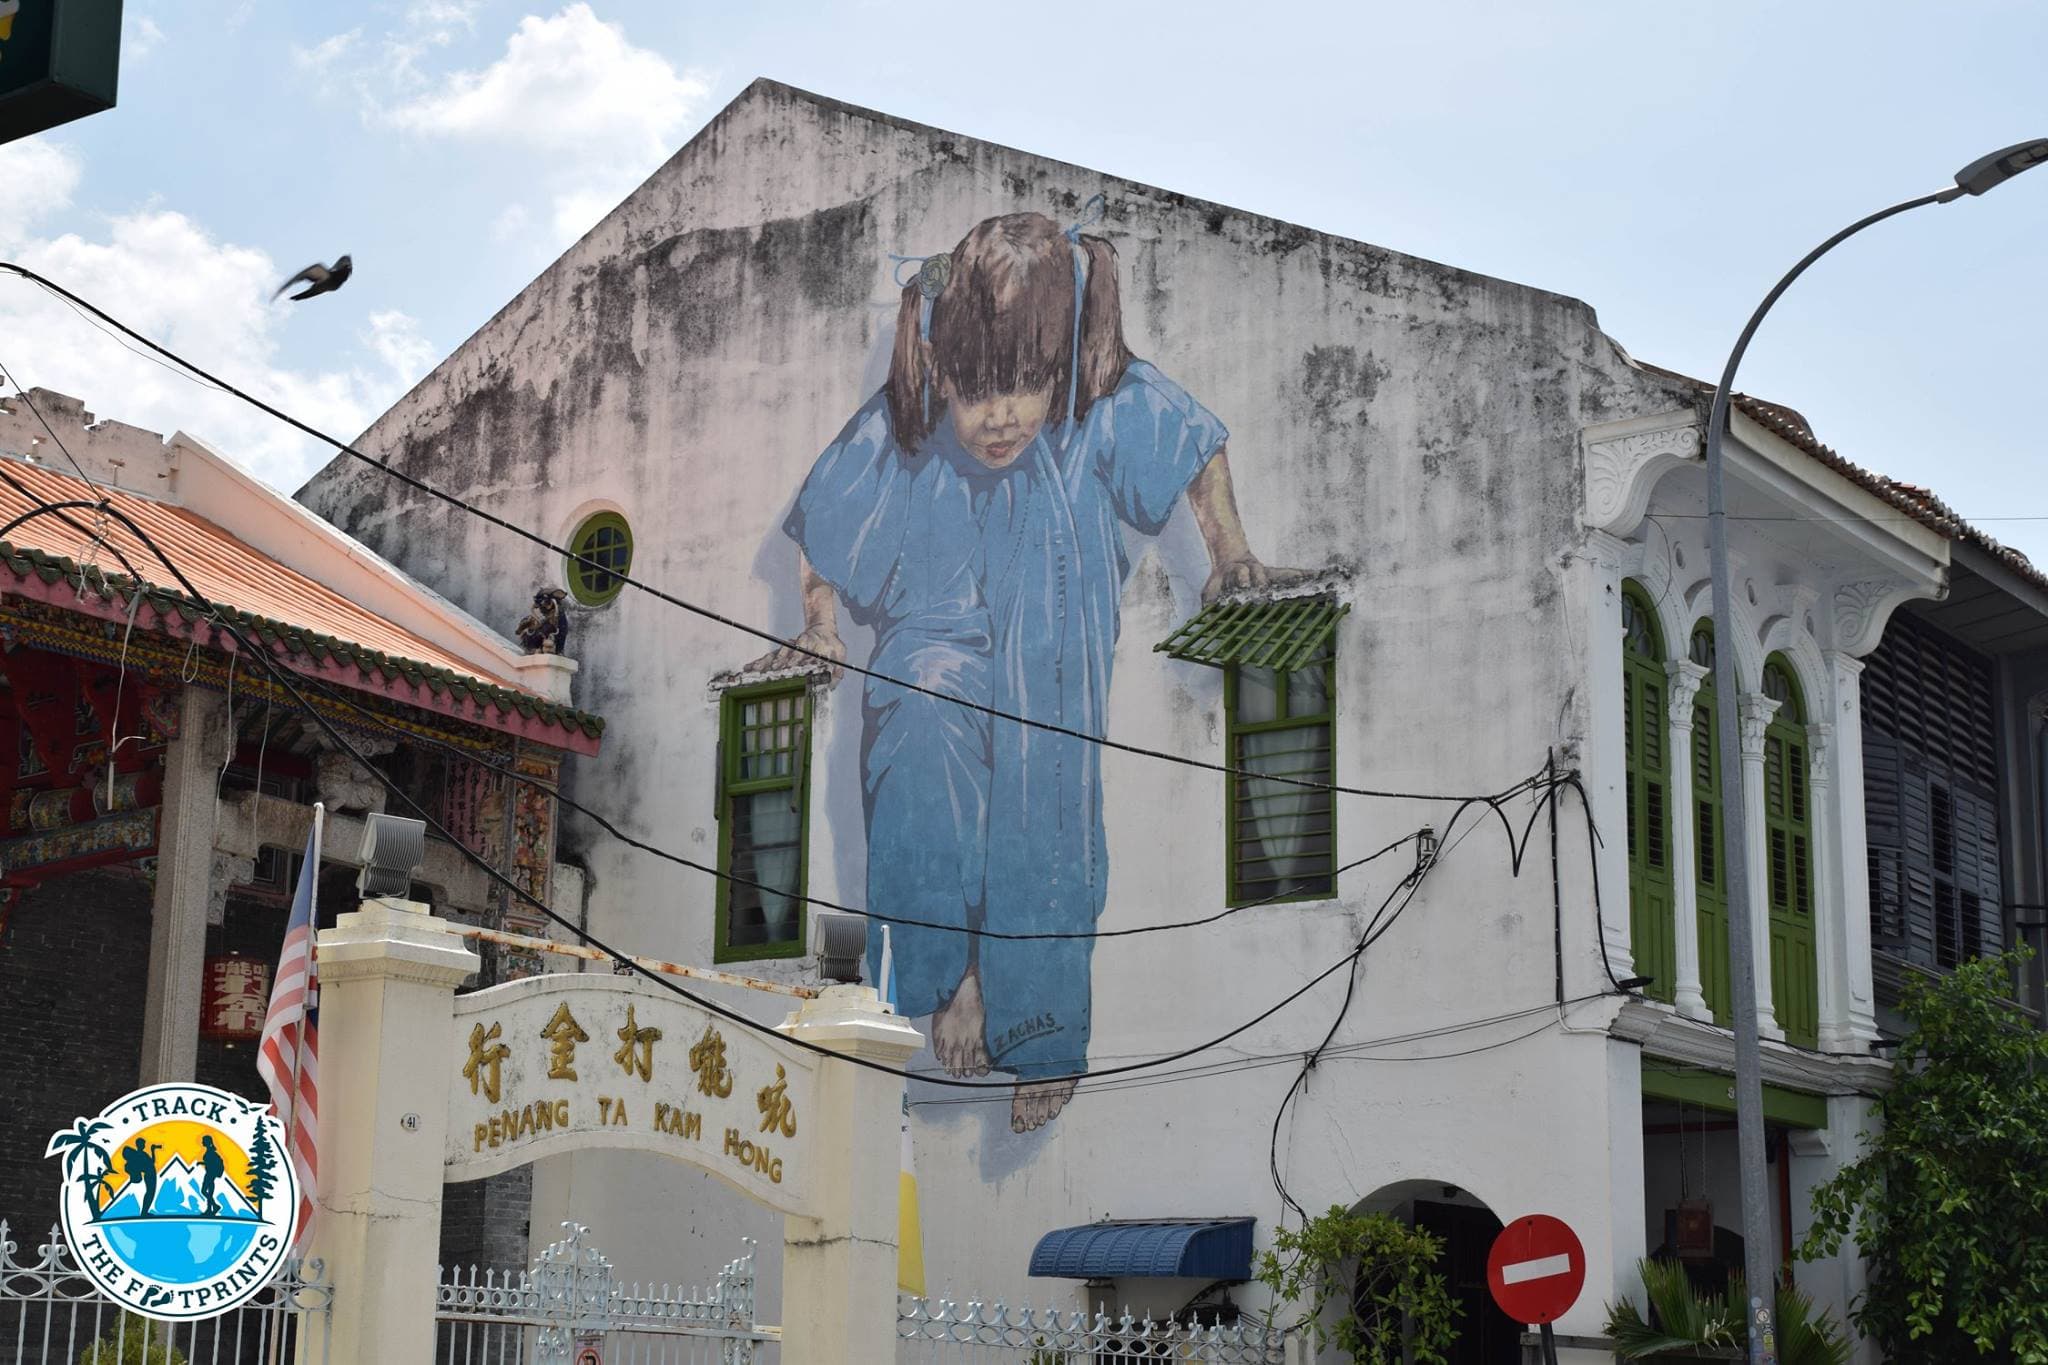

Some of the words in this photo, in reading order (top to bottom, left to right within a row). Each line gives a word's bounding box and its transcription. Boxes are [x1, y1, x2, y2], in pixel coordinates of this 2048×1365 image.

[473, 1099, 569, 1152] PENANG
[597, 1096, 629, 1126] TA
[654, 1102, 702, 1141] KAM
[723, 1127, 783, 1184] HONG
